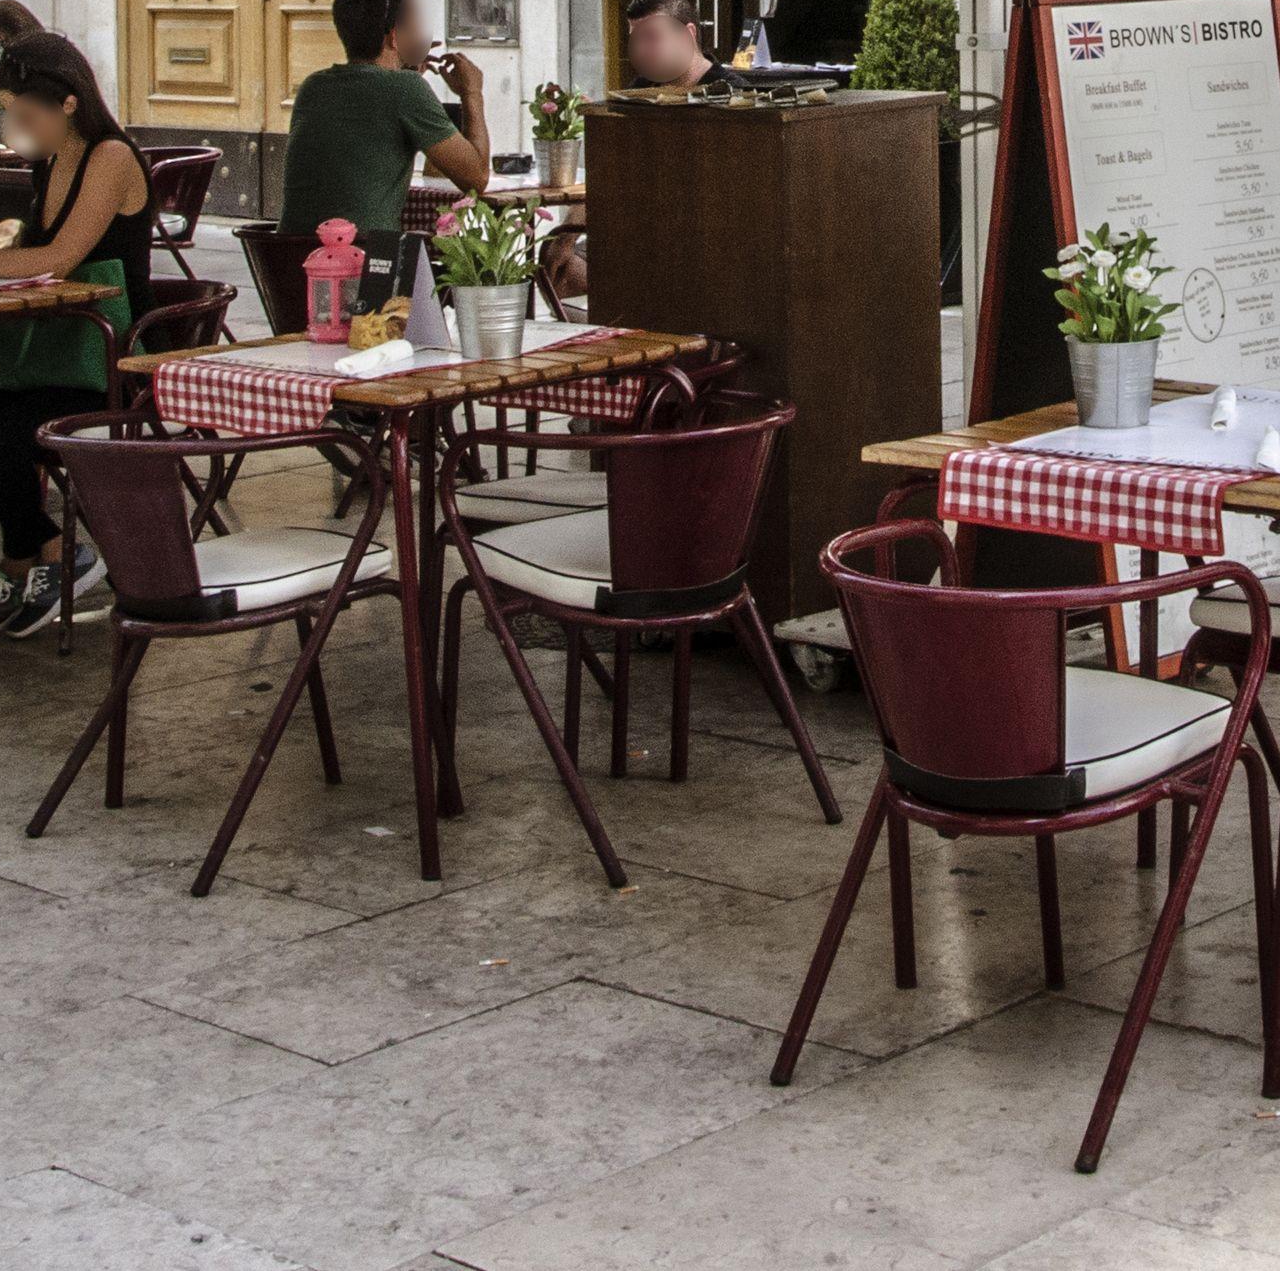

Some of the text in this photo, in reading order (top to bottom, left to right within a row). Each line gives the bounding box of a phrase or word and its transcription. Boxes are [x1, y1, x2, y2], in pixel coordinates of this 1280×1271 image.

[1109, 19, 1263, 49] BROWN'S BISTRO
[1084, 79, 1148, 97] Breakfast Buffet
[1206, 79, 1250, 94] Sandwiches
[1094, 148, 1153, 166] Toast & Bagels
